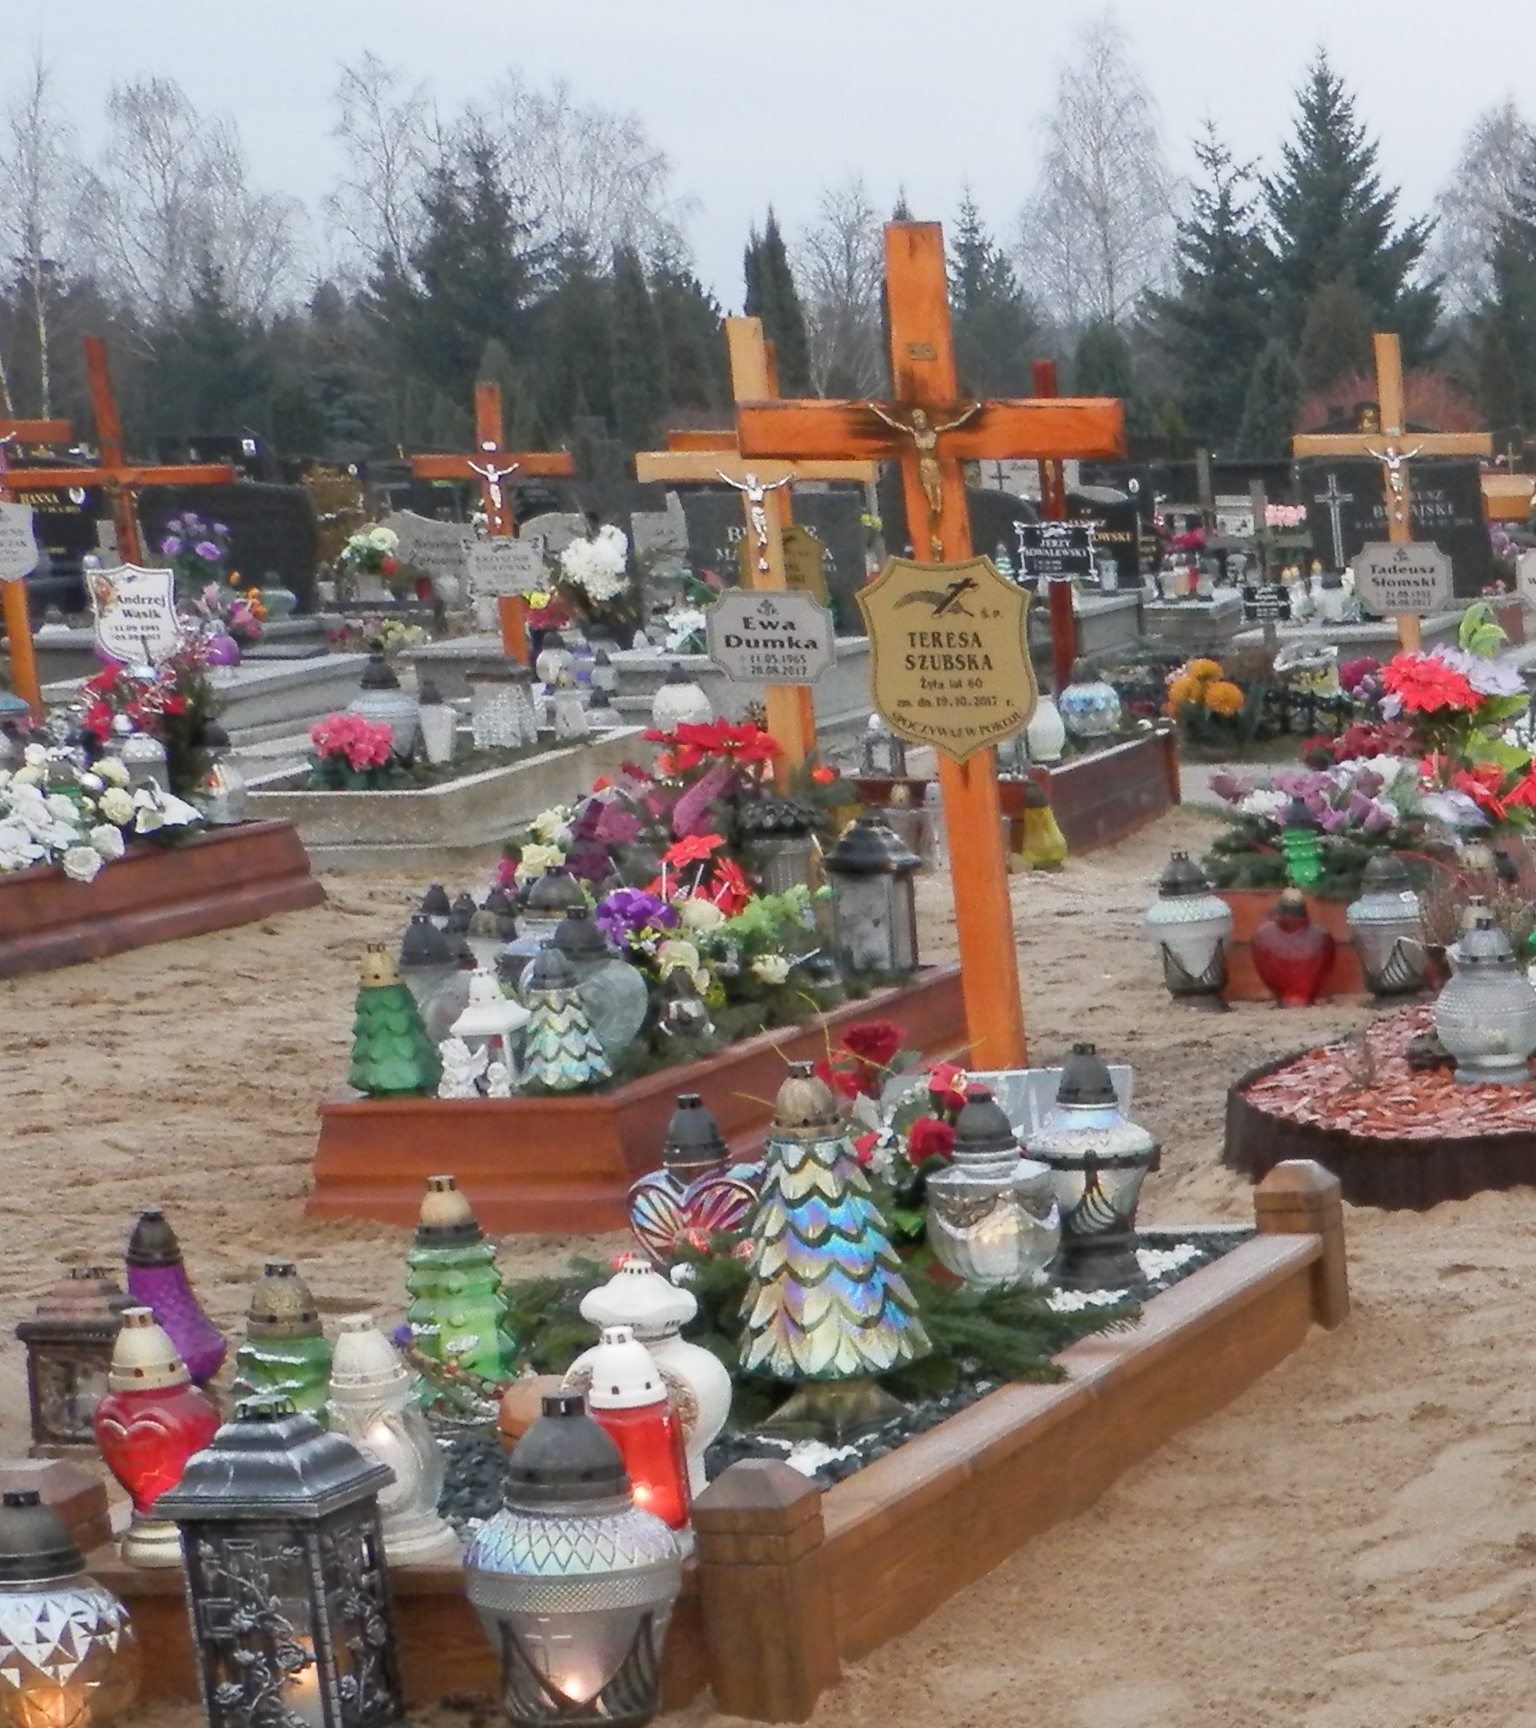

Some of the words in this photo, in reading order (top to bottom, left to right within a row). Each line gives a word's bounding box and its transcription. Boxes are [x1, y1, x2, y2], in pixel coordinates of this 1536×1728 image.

[1370, 564, 1435, 574] Tadeusz
[117, 594, 166, 608] Andrzej
[742, 616, 796, 630] Ewa
[725, 634, 819, 650] Dumka
[908, 631, 983, 649] TERESA
[905, 654, 994, 671] SZUBSKA
